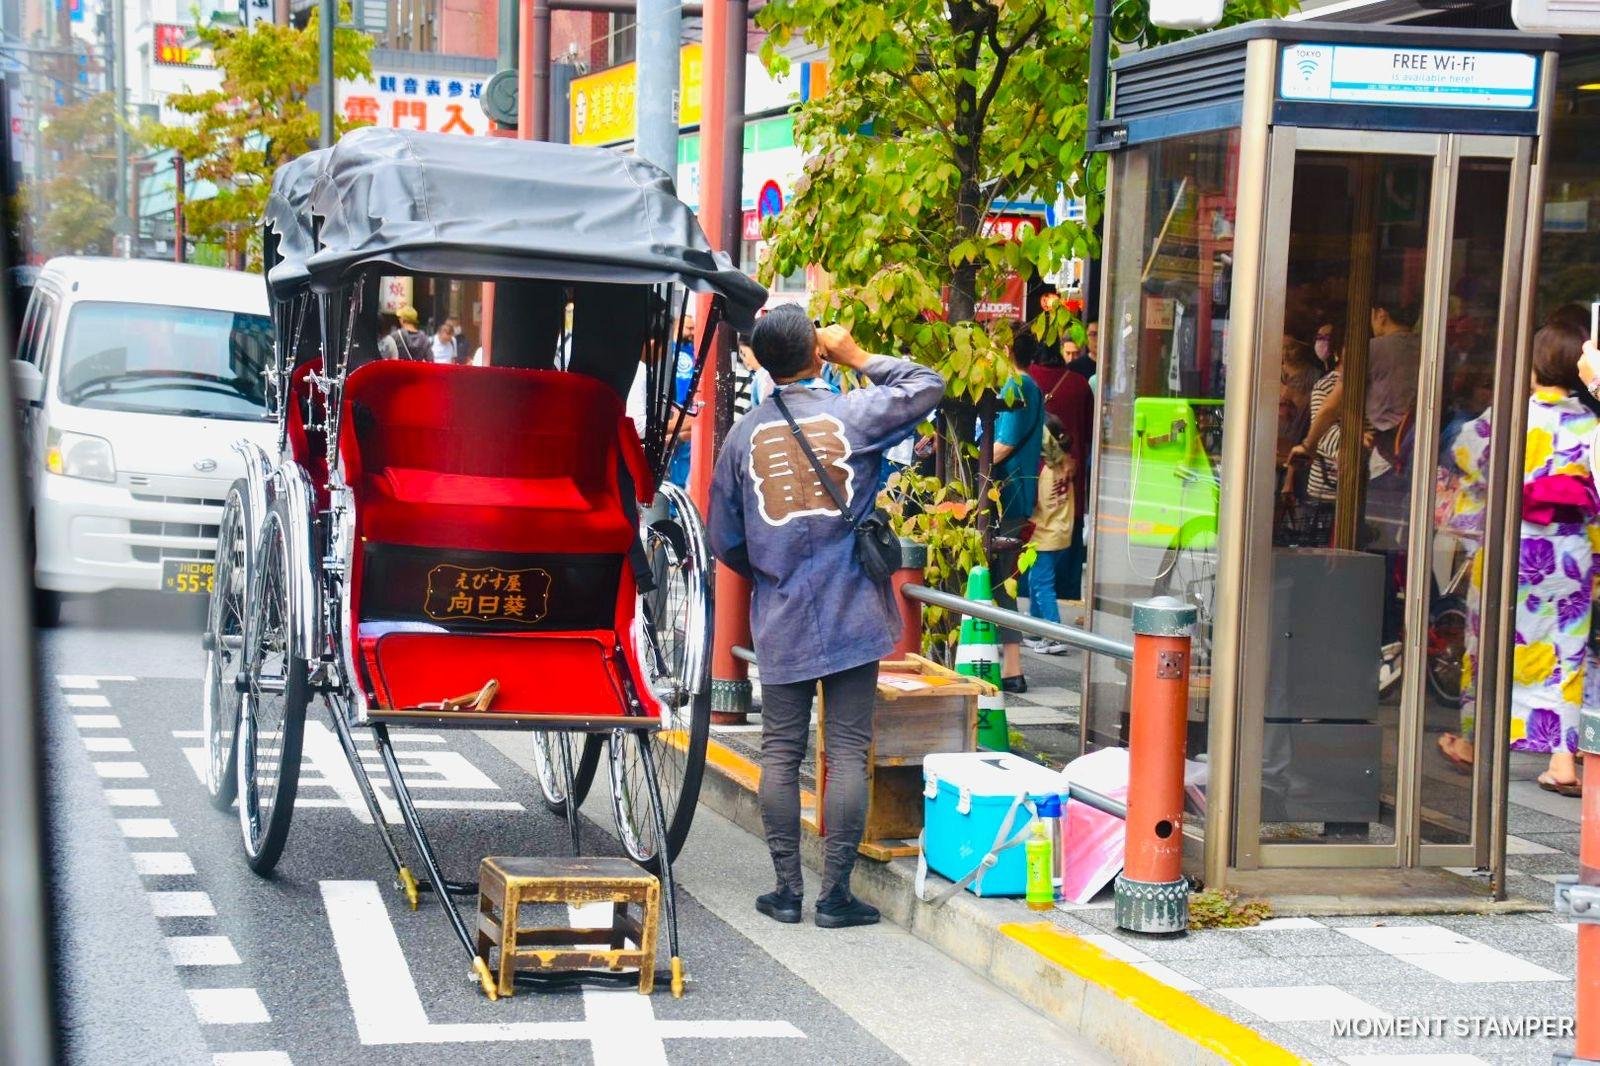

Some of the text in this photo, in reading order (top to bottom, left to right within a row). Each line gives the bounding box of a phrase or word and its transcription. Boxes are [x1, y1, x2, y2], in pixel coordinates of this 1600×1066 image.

[1296, 49, 1322, 58] TOKYO
[1393, 53, 1477, 72] FREE Wi-Fi
[1403, 74, 1447, 83] available
[455, 572, 522, 592] えびす屋
[447, 591, 527, 617] 向日葵
